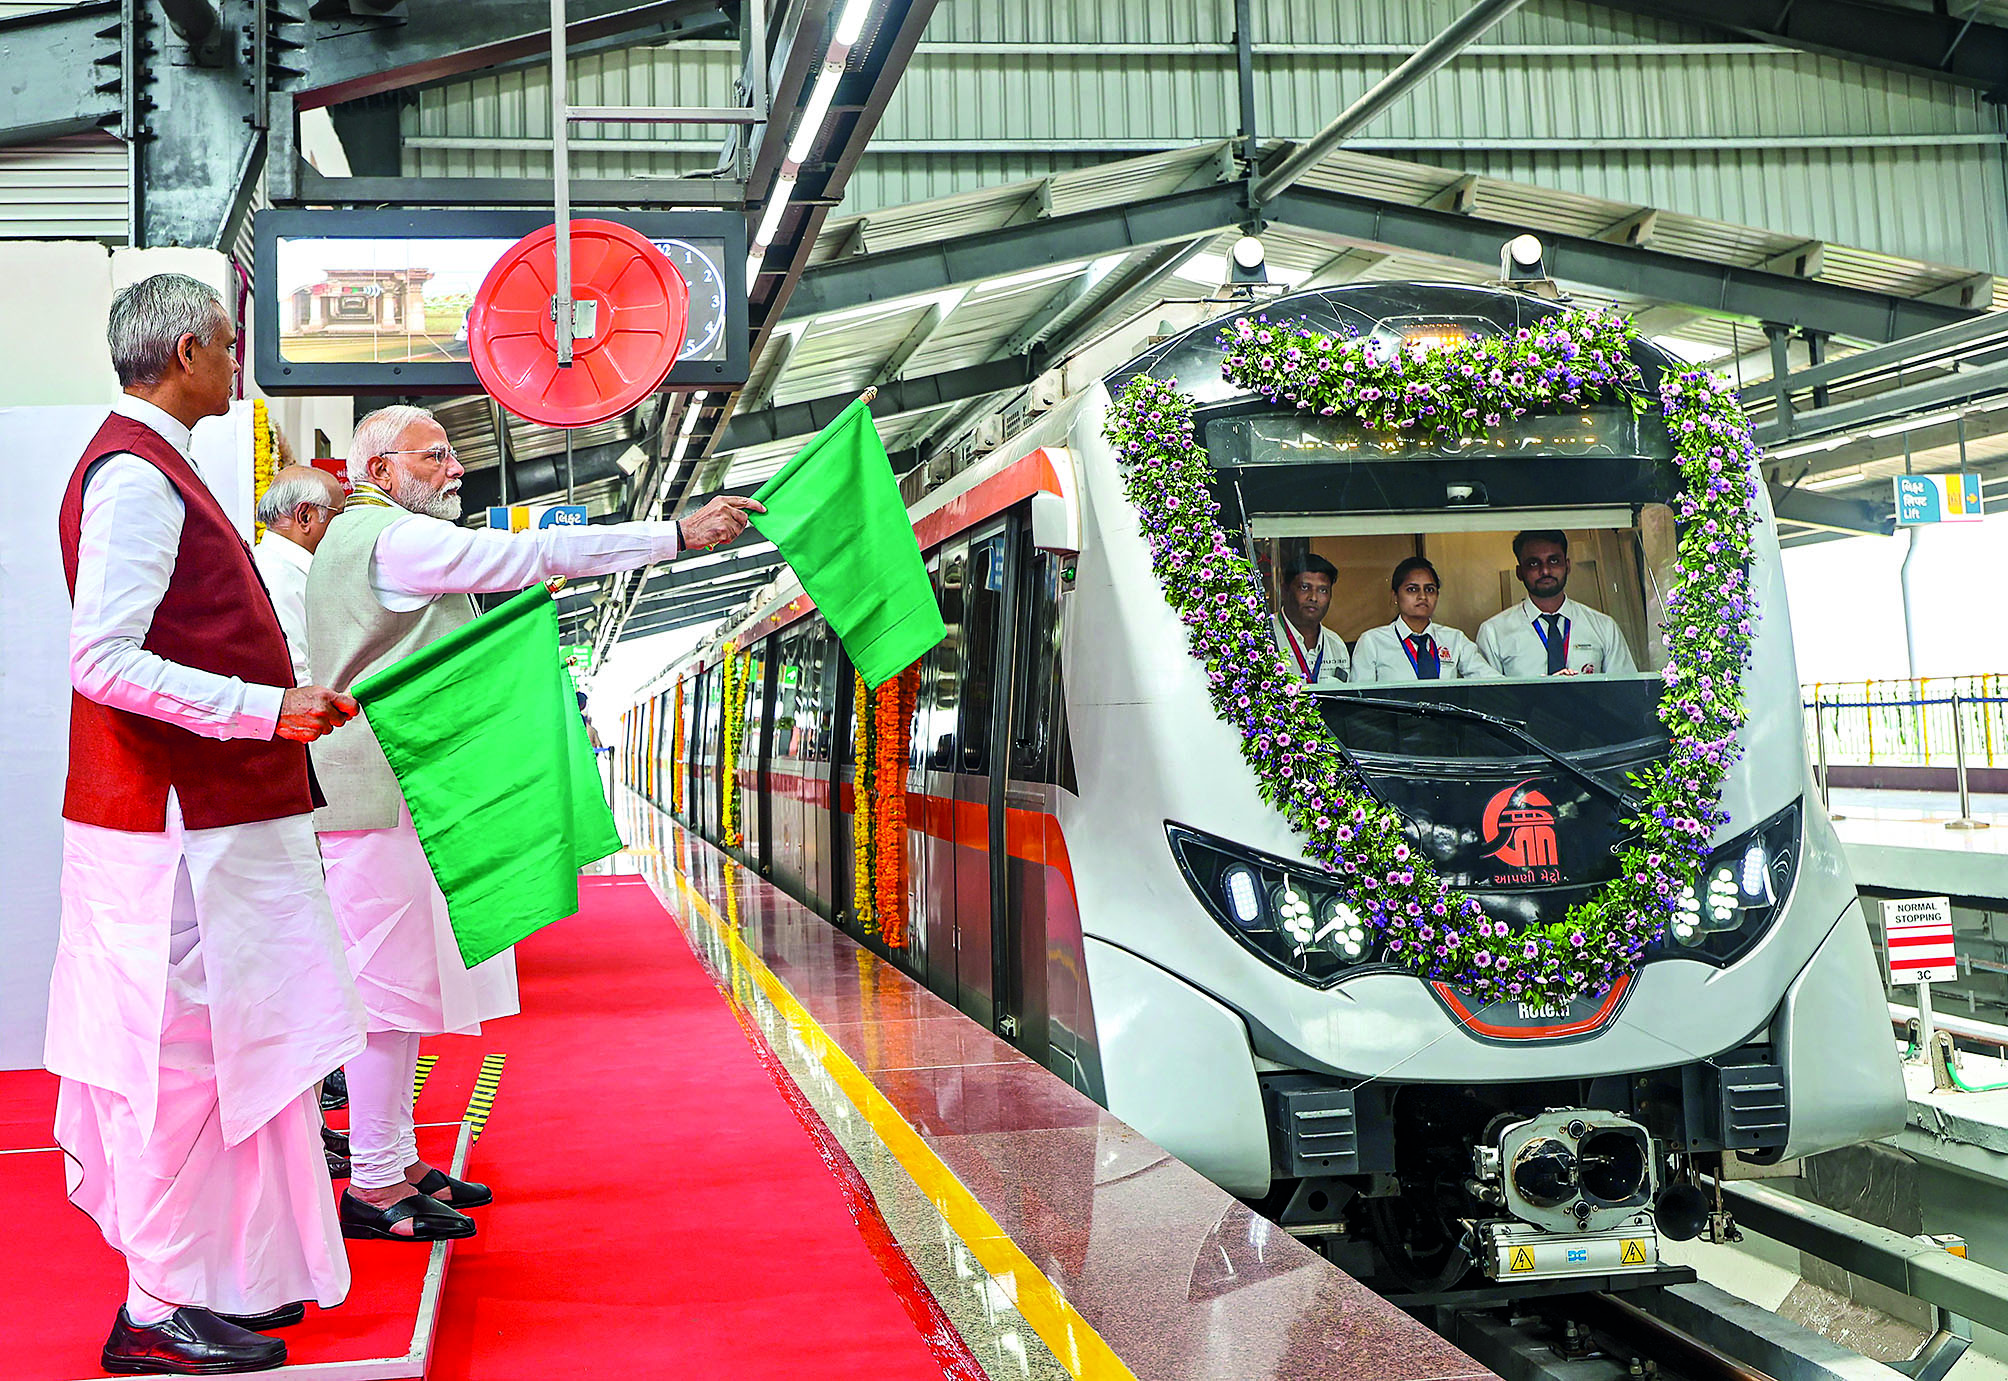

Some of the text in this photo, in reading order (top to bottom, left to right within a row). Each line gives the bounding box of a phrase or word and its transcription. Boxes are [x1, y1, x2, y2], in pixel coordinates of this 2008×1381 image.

[685, 250, 693, 264] 1
[703, 269, 713, 283] 2
[710, 294, 720, 308] 3
[704, 320, 715, 334] 4
[686, 338, 696, 352] 5
[1903, 507, 1921, 520] Lift
[1494, 868, 1560, 884] આપણી મેટ્રો
[1897, 902, 1938, 912] NORMAL
[1895, 913, 1942, 924] STOPPING
[1917, 970, 1931, 980] 3C
